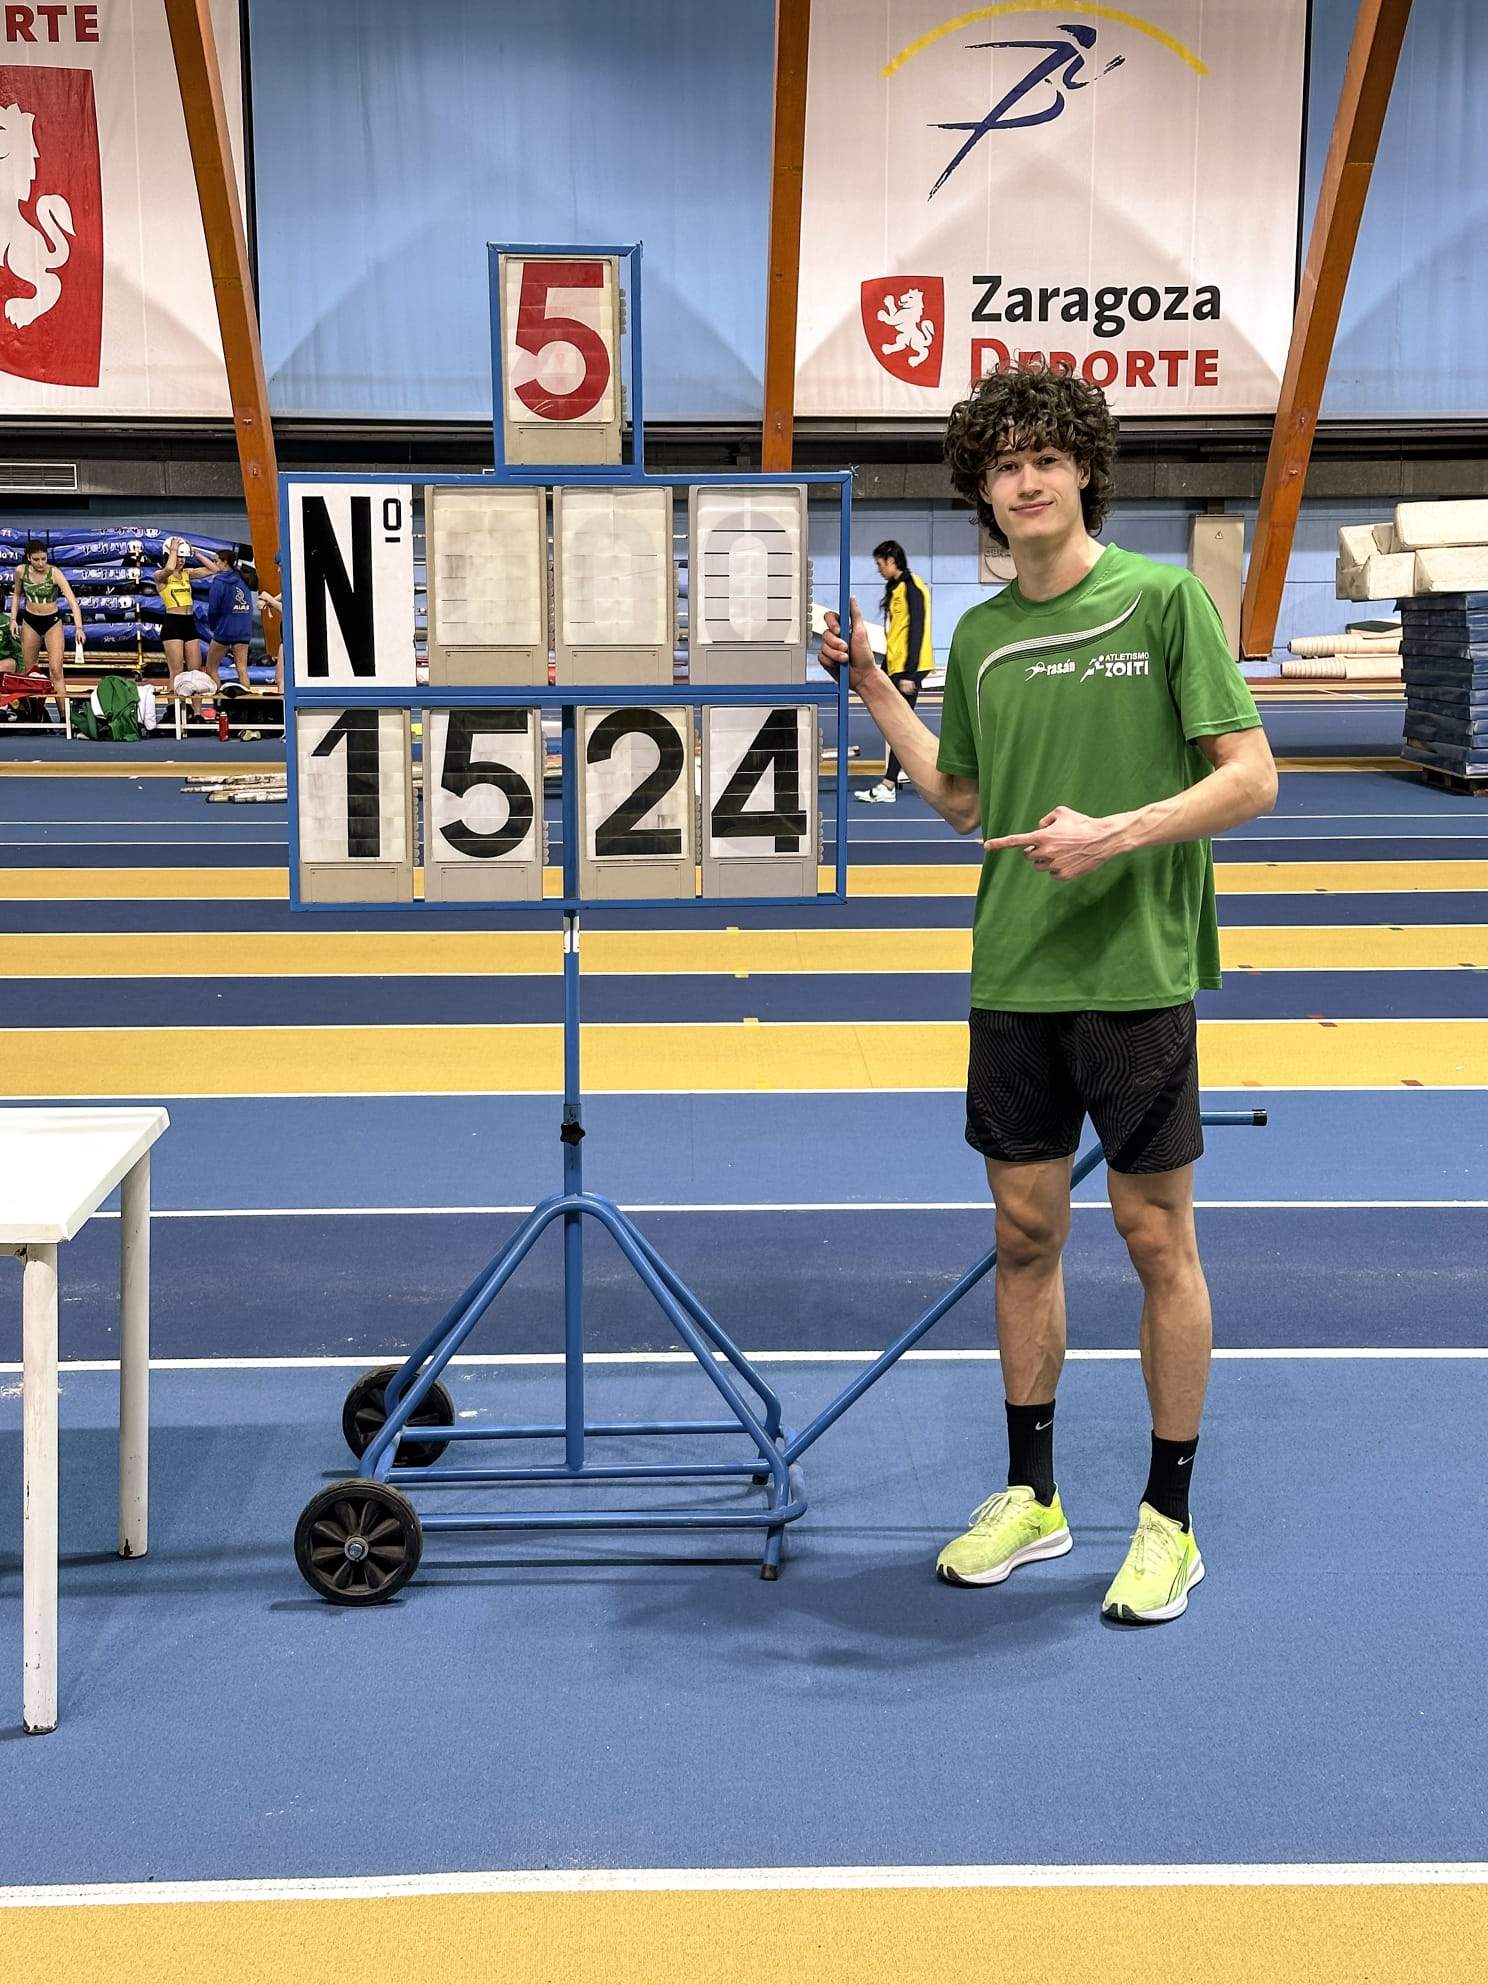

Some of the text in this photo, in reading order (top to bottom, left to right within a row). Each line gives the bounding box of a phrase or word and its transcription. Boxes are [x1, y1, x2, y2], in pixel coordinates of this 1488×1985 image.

[5, 5, 99, 42] RTE
[972, 275, 1221, 338] Zaragoza
[514, 262, 611, 420] 5
[1104, 652, 1150, 662] ATLETISMO
[1104, 660, 1149, 677] ZOITI
